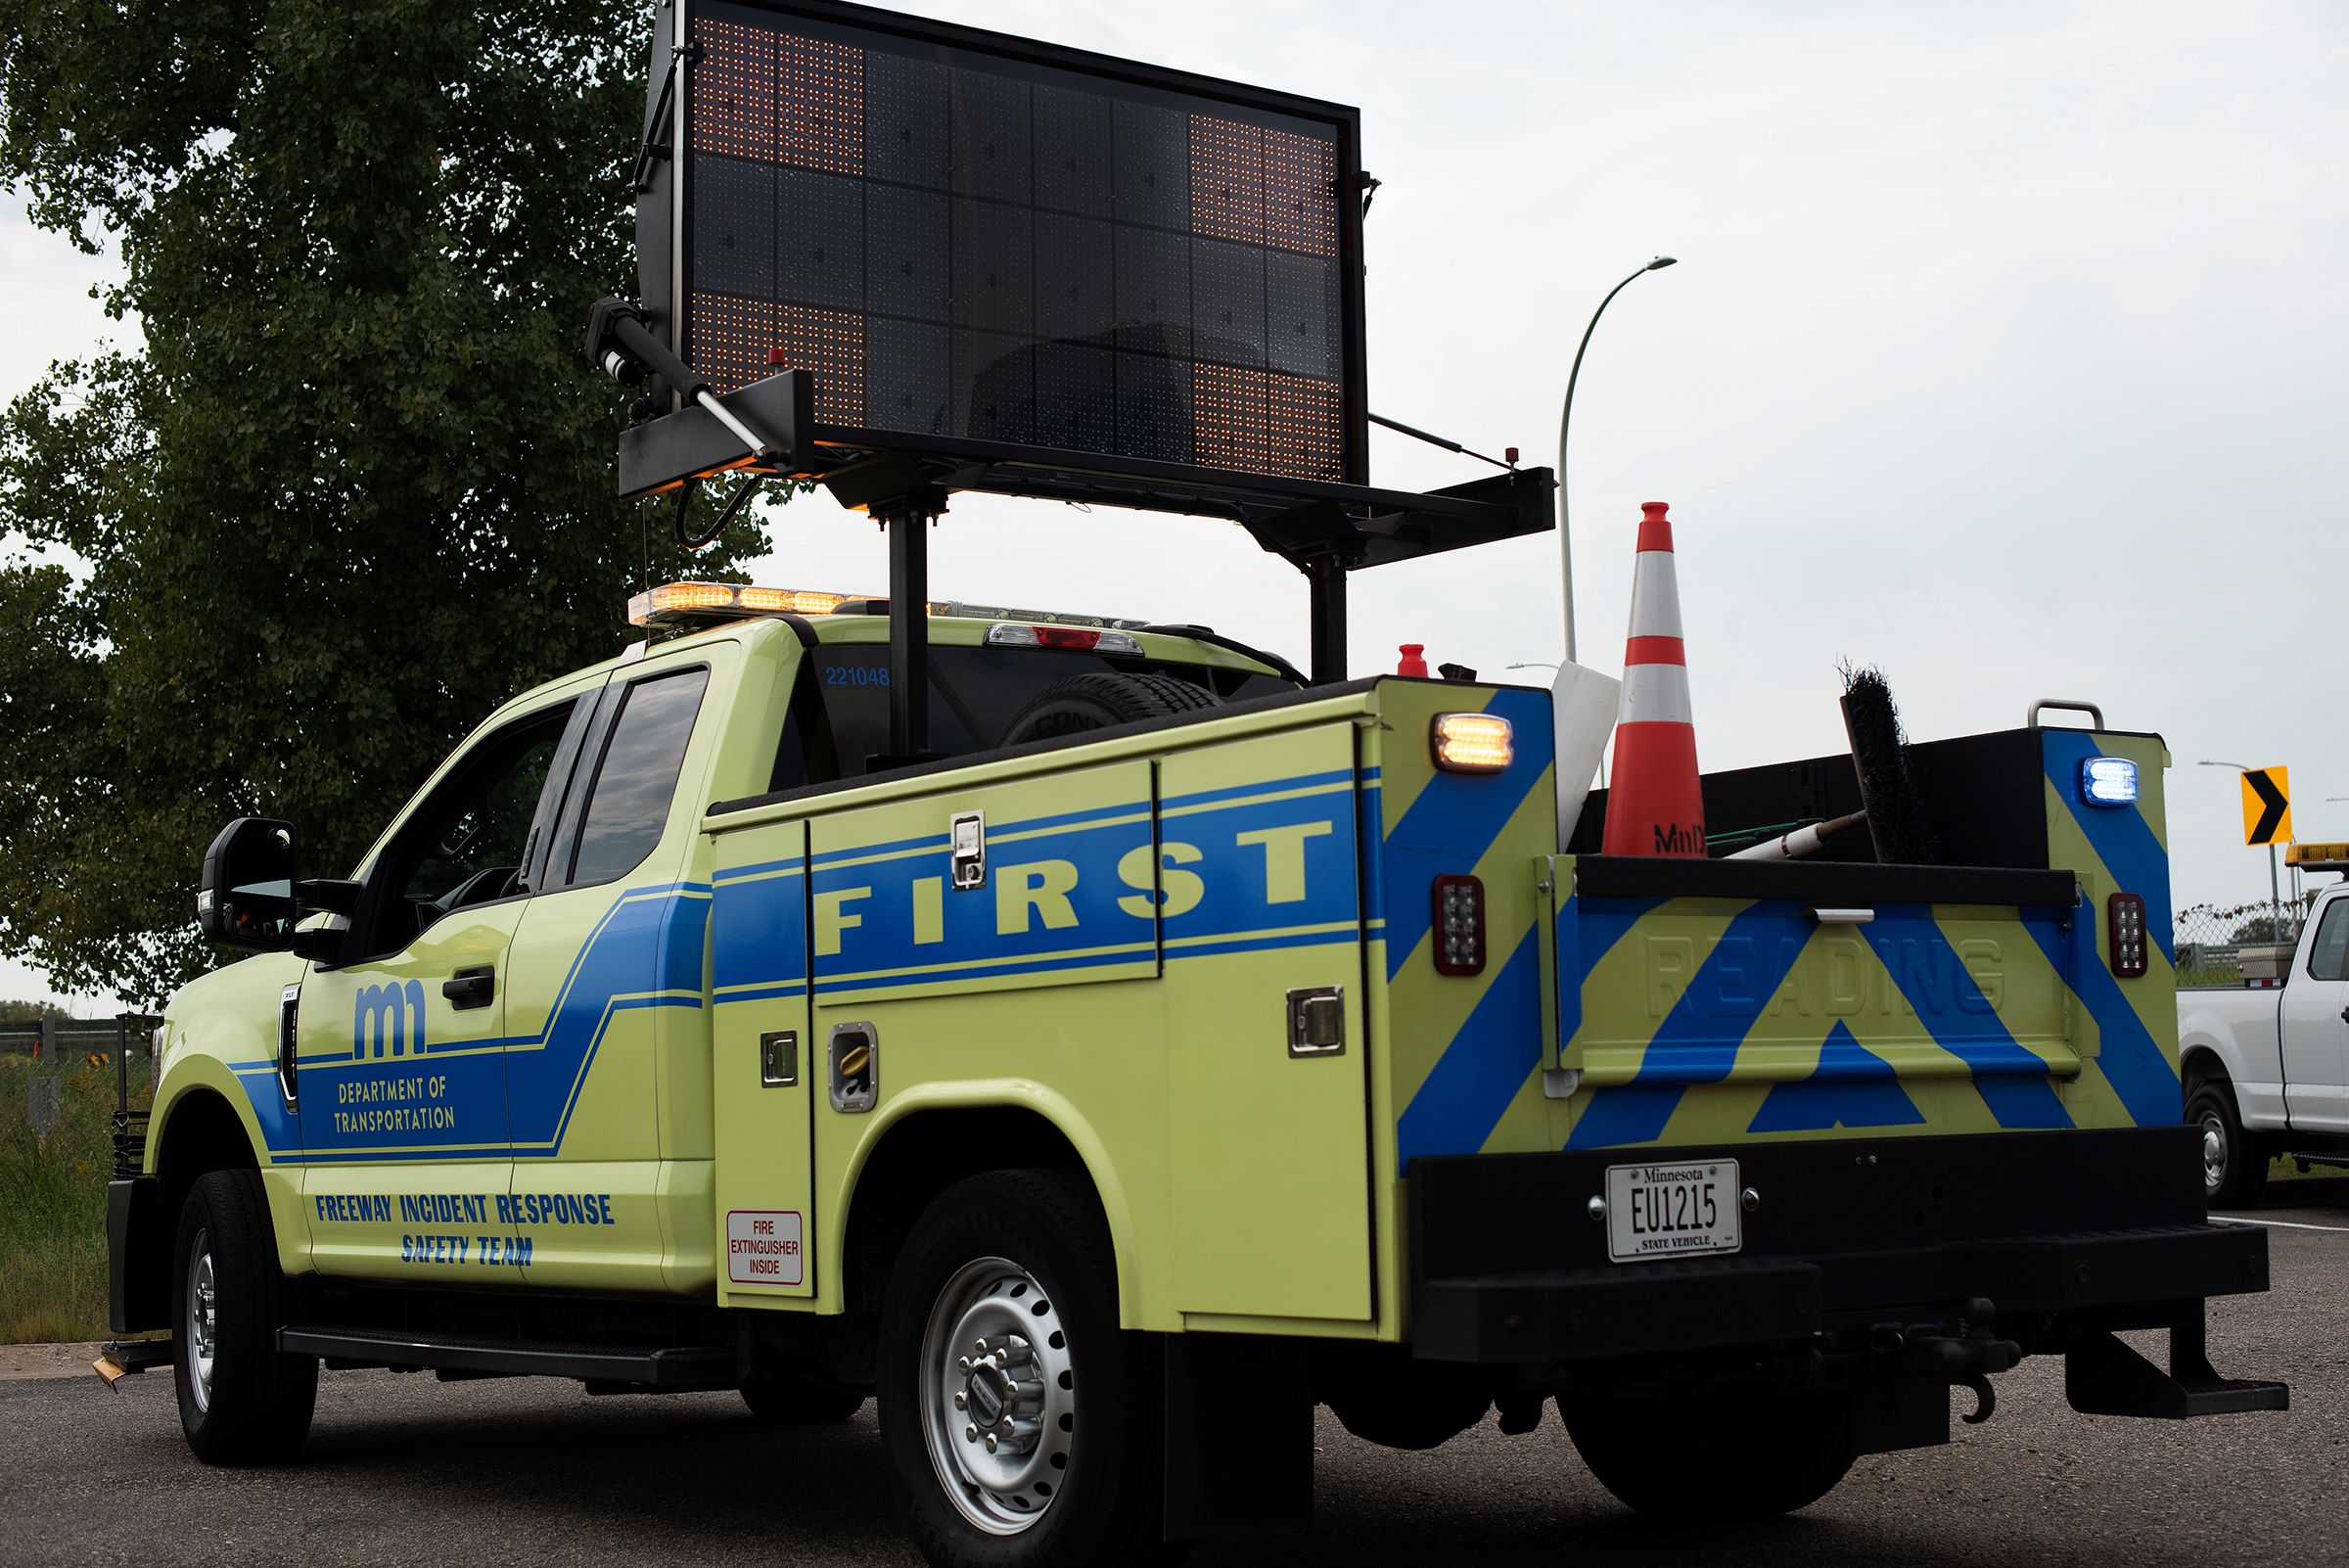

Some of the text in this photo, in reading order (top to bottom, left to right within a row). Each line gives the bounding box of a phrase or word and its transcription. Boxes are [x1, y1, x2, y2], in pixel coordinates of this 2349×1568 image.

[825, 667, 890, 686] 221048
[813, 820, 1333, 956] FIRST
[1644, 936, 2005, 1019] READING
[339, 1076, 446, 1104] DEPARTMENT OF
[334, 1106, 455, 1133] TRANSPORTATION
[1644, 1167, 1703, 1183] Minnesota
[315, 1194, 616, 1224] FREEWAY INCIDENT RESPONSE
[1632, 1183, 1716, 1234] EU1215
[753, 1221, 774, 1234] FIRE
[400, 1234, 533, 1267] SAFETY TEAM
[731, 1239, 799, 1255] EXTINGUISHER
[1641, 1238, 1670, 1250] STATE
[1672, 1235, 1711, 1248] VEHICLE
[750, 1260, 780, 1274] INSIDE
